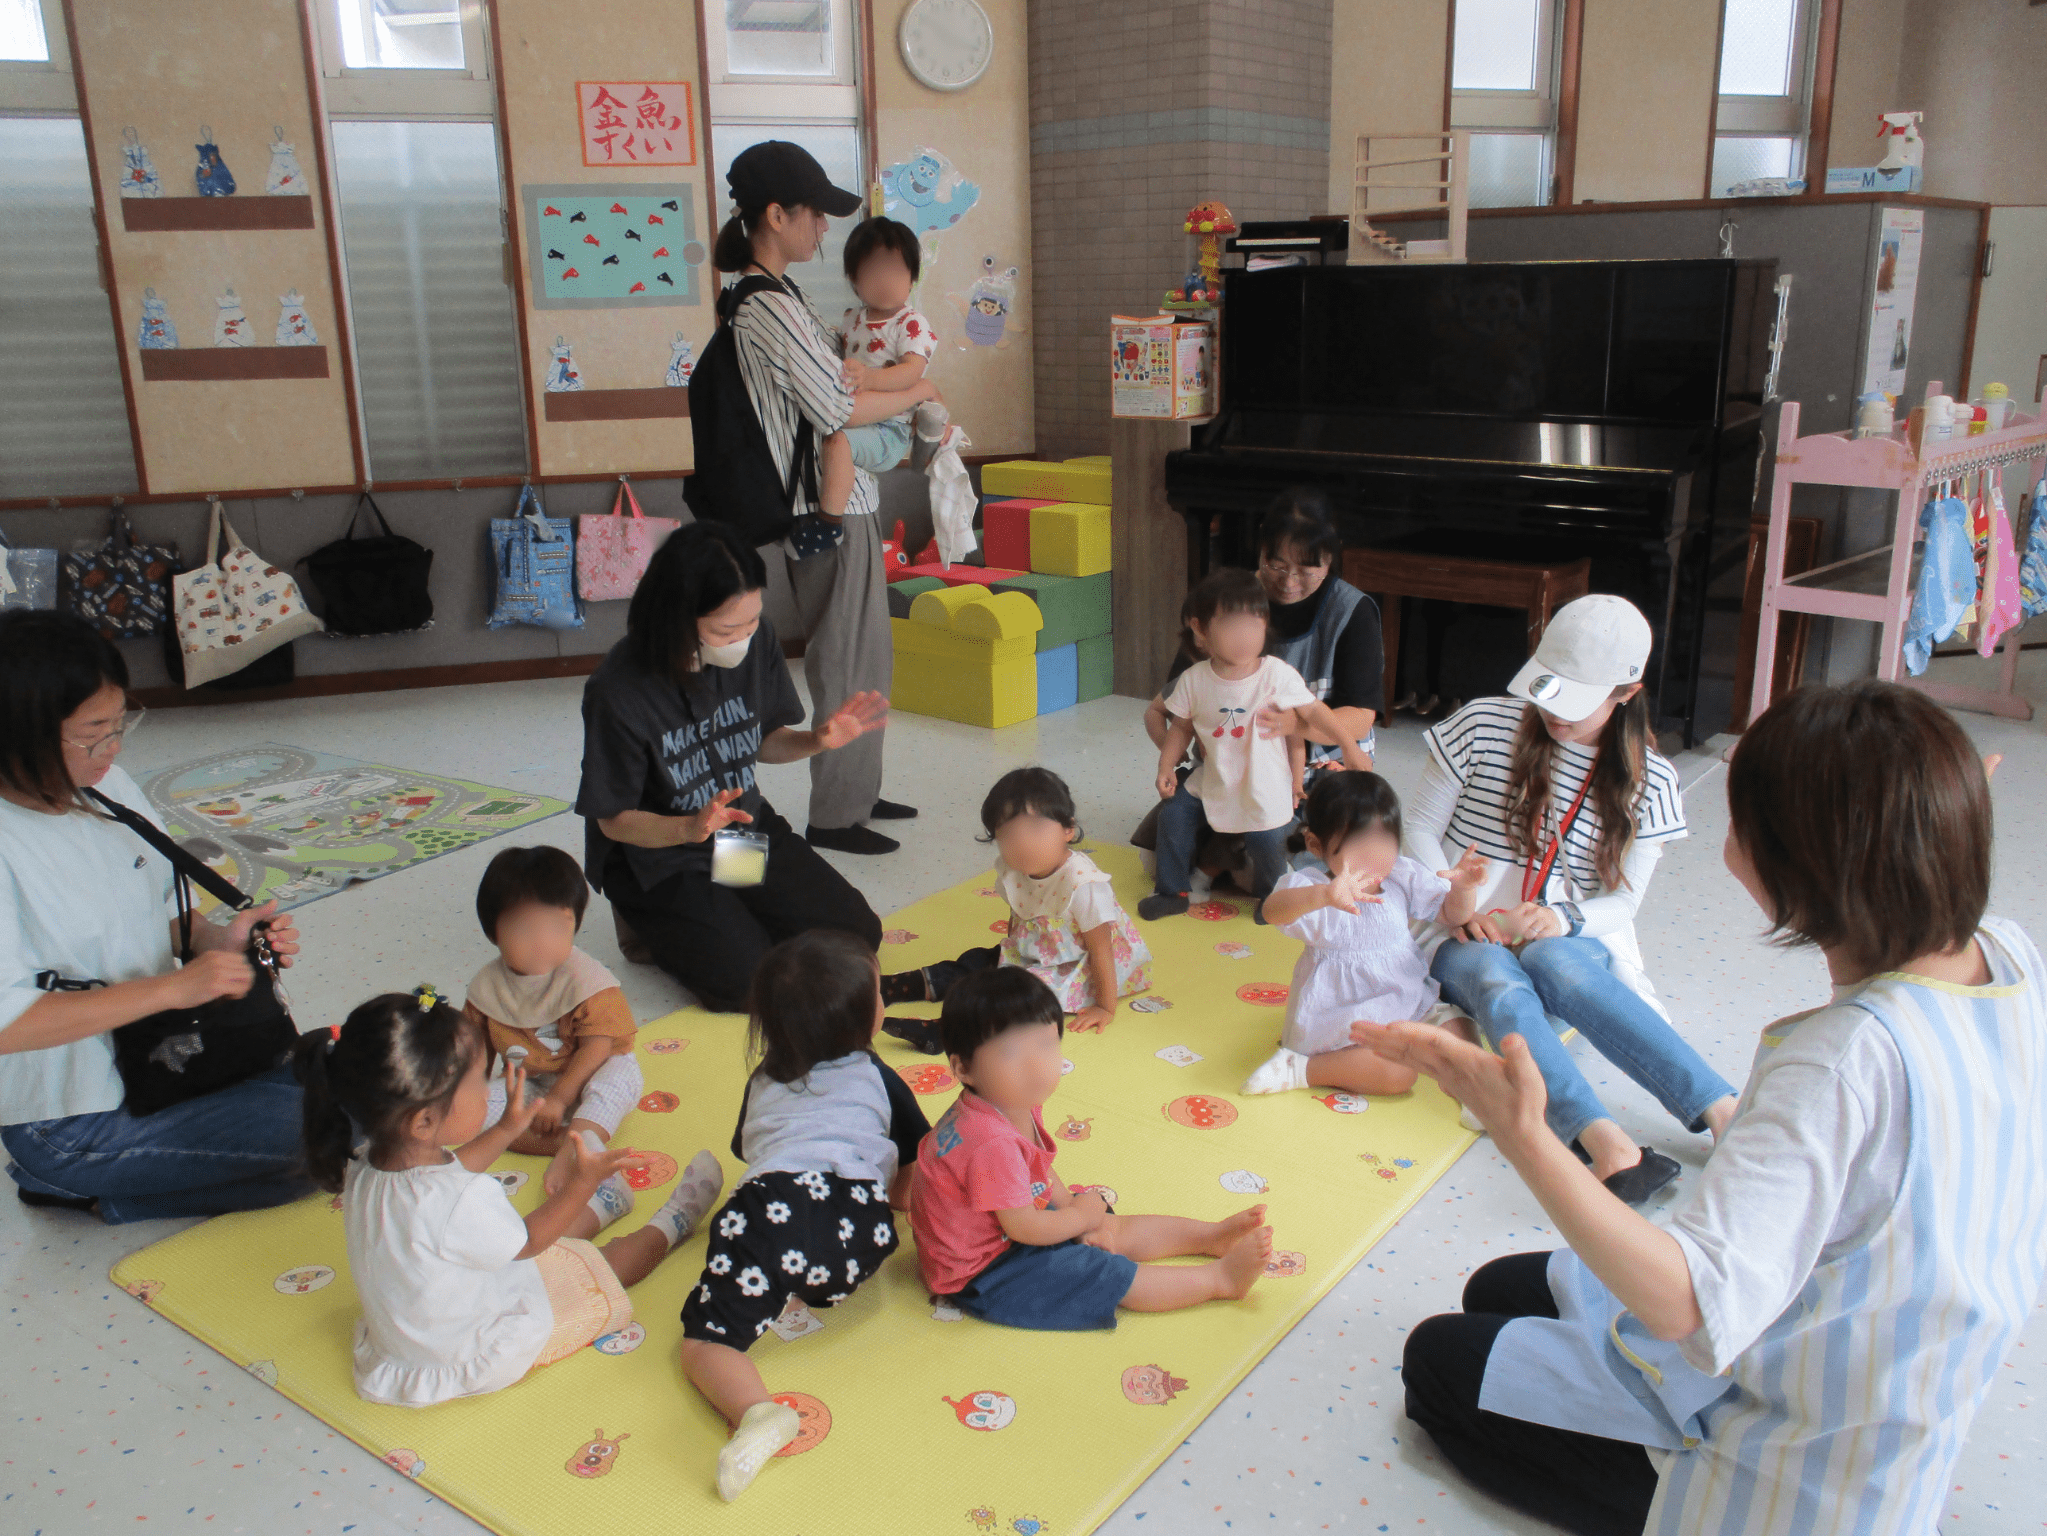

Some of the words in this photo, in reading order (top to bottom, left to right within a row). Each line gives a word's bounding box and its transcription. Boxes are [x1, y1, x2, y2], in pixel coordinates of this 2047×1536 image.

[588, 86, 682, 130] 金魚
[592, 130, 673, 161] すくい
[1861, 171, 1876, 188] M
[662, 718, 710, 758] MAKE
[667, 746, 711, 790] MAKE
